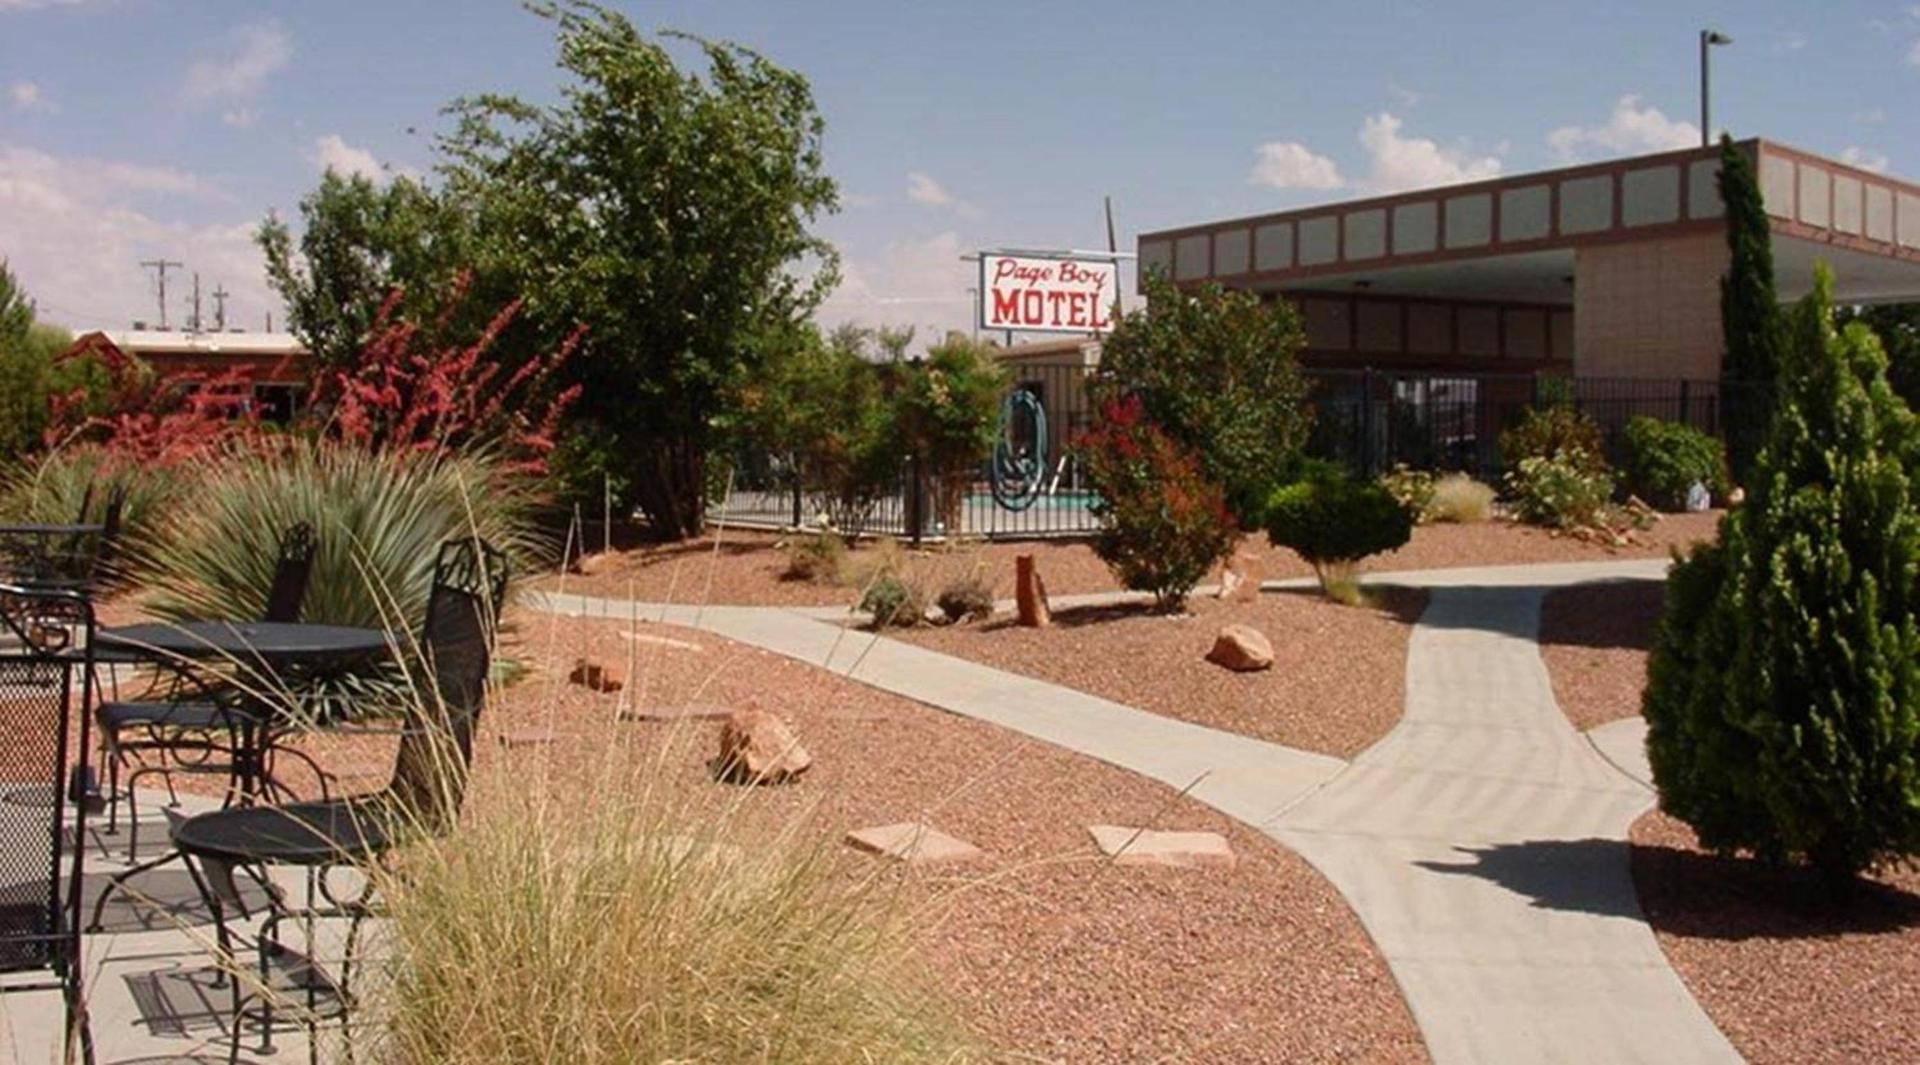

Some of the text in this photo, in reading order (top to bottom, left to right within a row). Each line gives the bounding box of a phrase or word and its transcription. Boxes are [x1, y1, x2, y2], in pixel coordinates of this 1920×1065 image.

[994, 257, 1107, 291] Page Boy
[991, 288, 1109, 328] MOTEL
